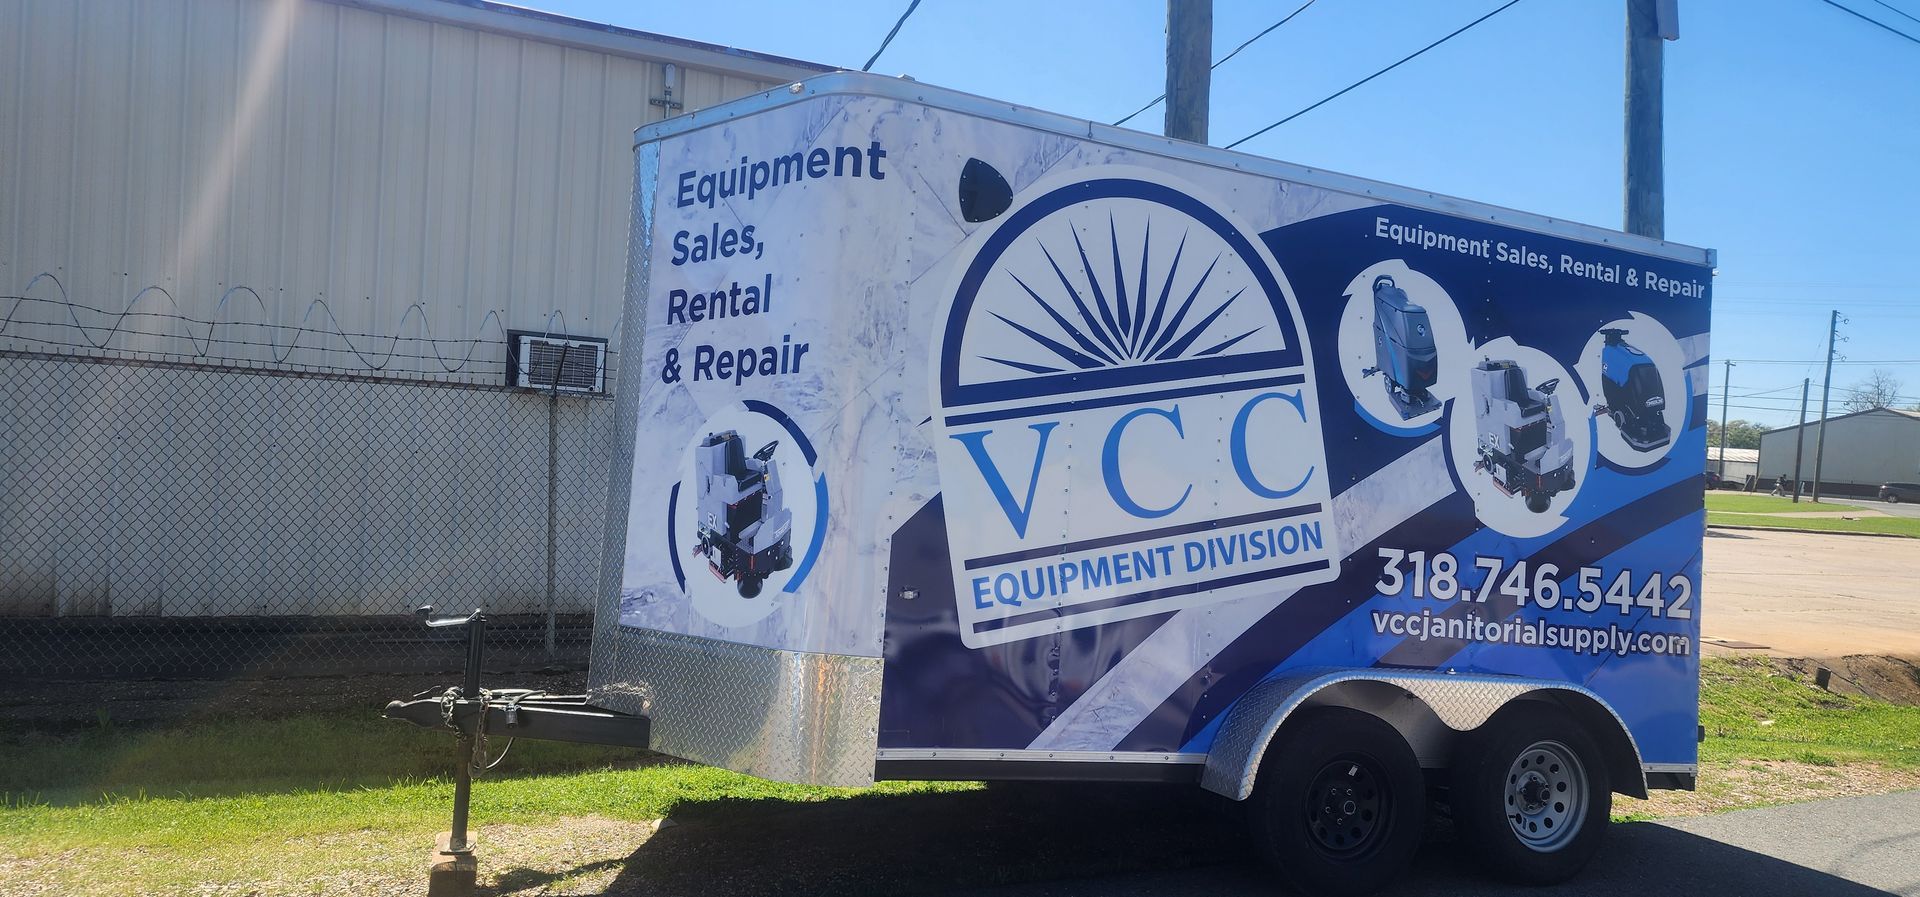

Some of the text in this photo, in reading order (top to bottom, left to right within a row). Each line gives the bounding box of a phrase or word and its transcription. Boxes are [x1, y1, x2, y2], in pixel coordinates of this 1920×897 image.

[677, 141, 887, 209] Equipment
[671, 222, 764, 266] Sales,
[1375, 216, 1705, 299] Equipment Sales, Rental & Repair
[667, 273, 772, 325] Rental
[661, 334, 809, 386] & Repair
[972, 521, 1323, 609] EQUIPMENT DIVISION
[1375, 547, 1692, 619] 318.746.5442
[1372, 610, 1690, 655] vccjanitorialsupply.com
